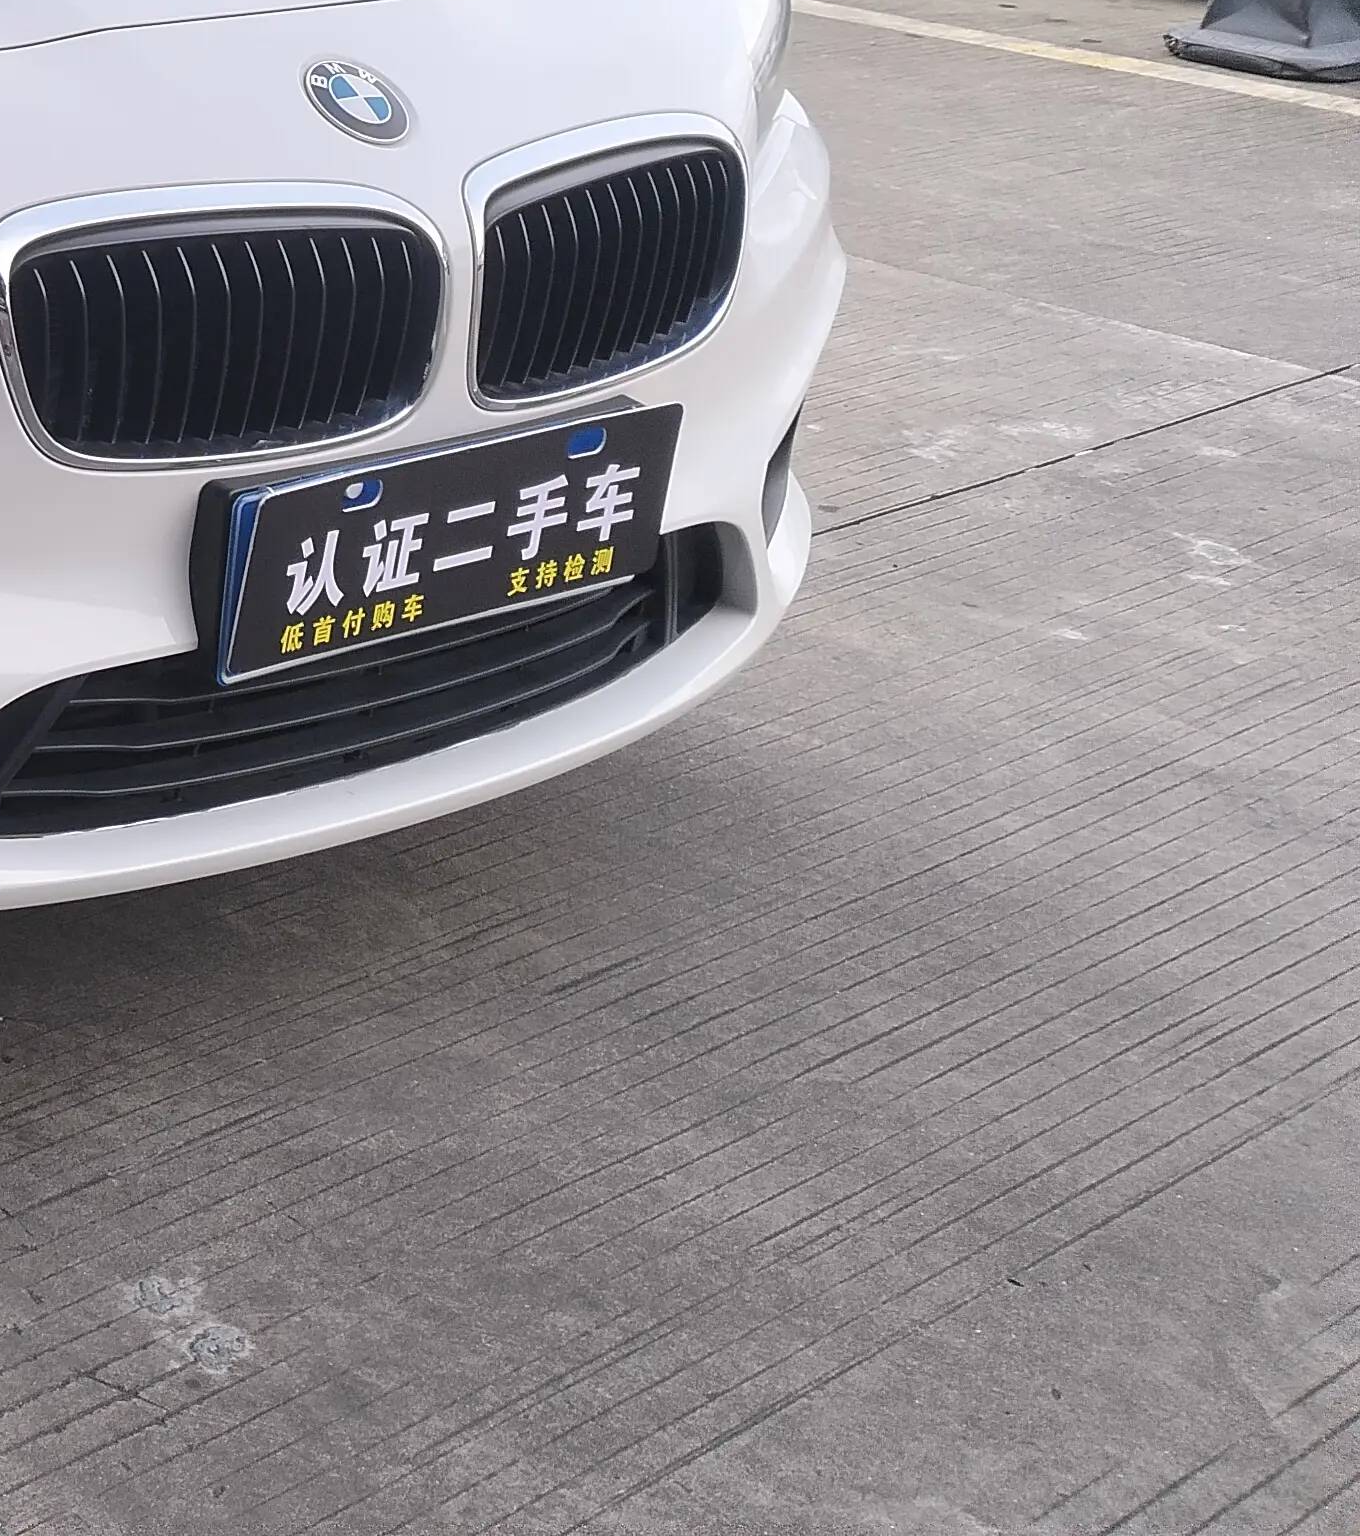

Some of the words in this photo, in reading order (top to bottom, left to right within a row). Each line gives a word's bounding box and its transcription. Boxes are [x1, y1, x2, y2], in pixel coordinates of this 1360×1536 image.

[310, 63, 378, 89] BMW
[285, 463, 641, 616] 认证二手车
[506, 546, 615, 597] 支持检测
[280, 594, 424, 654] 低首付购车
